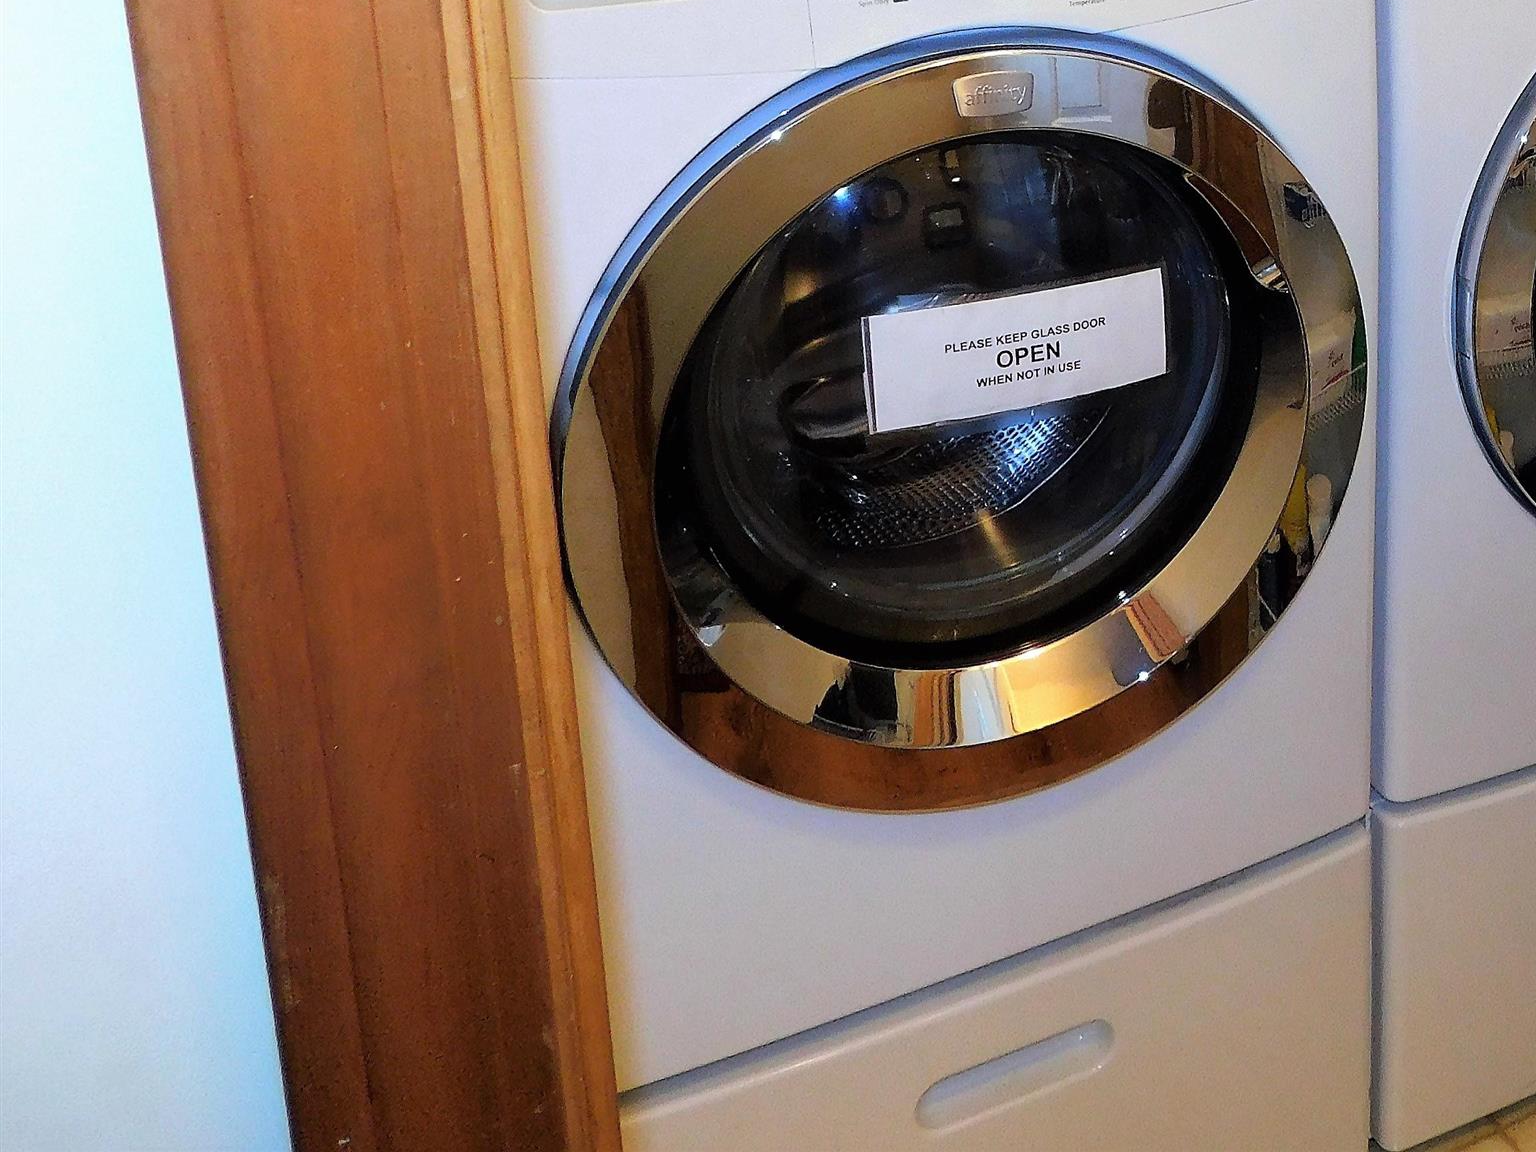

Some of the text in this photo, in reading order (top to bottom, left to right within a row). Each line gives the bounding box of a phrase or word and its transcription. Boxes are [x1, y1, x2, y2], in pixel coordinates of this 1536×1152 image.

[964, 84, 1027, 106] affinity
[944, 316, 1106, 354] PLEASE KEEP GLASS DOOR
[996, 341, 1061, 369] OPEN
[976, 359, 1082, 389] WHEN NOT IN USE
